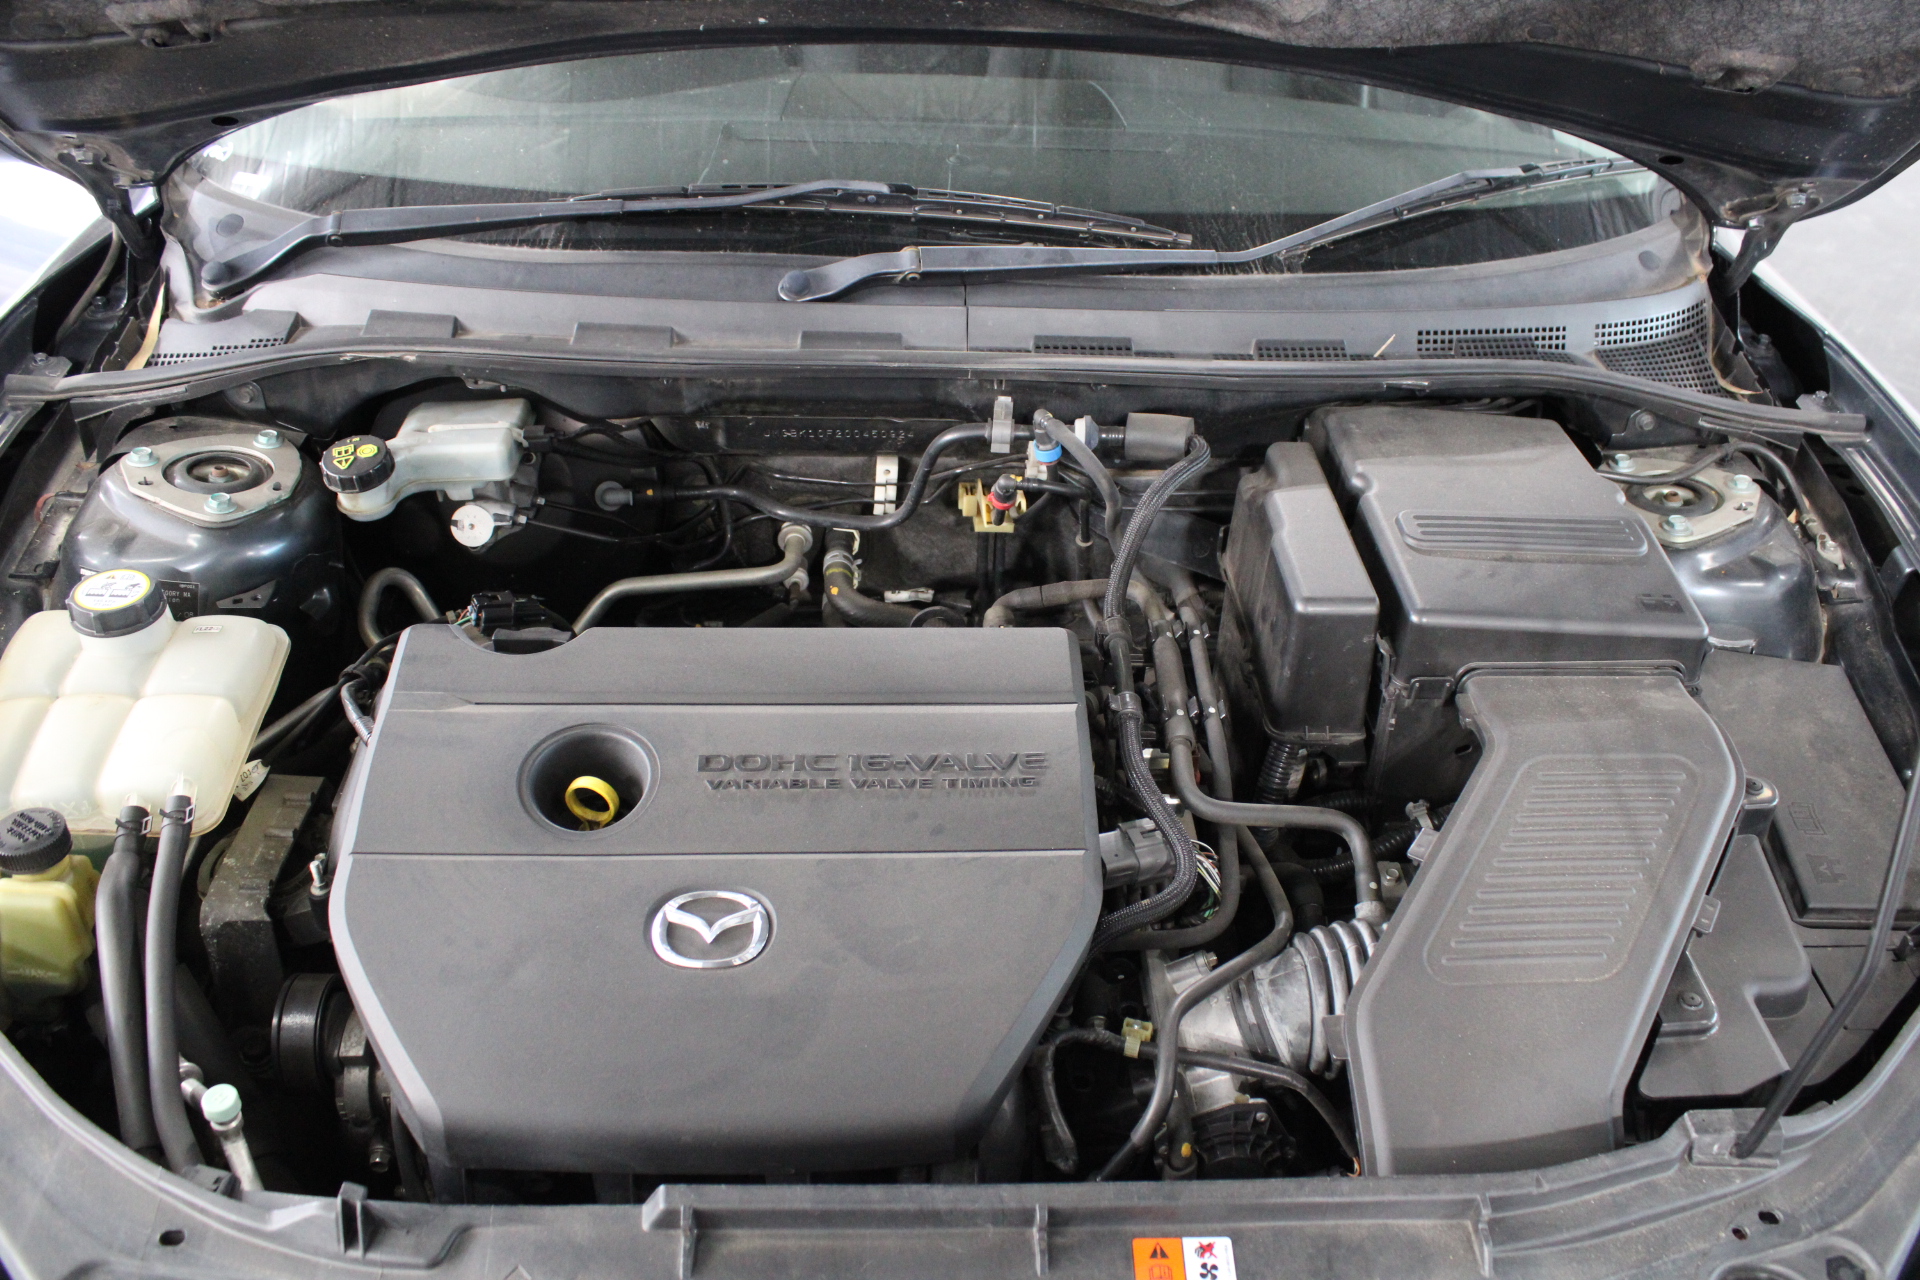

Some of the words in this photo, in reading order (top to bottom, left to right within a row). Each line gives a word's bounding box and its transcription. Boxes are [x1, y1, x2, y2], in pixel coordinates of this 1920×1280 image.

[697, 754, 838, 772] DOHC
[848, 752, 1047, 772] 16-VALVE
[704, 778, 842, 790] VARIABLE
[850, 777, 933, 790] VALVE
[942, 776, 1040, 788] TIMING
